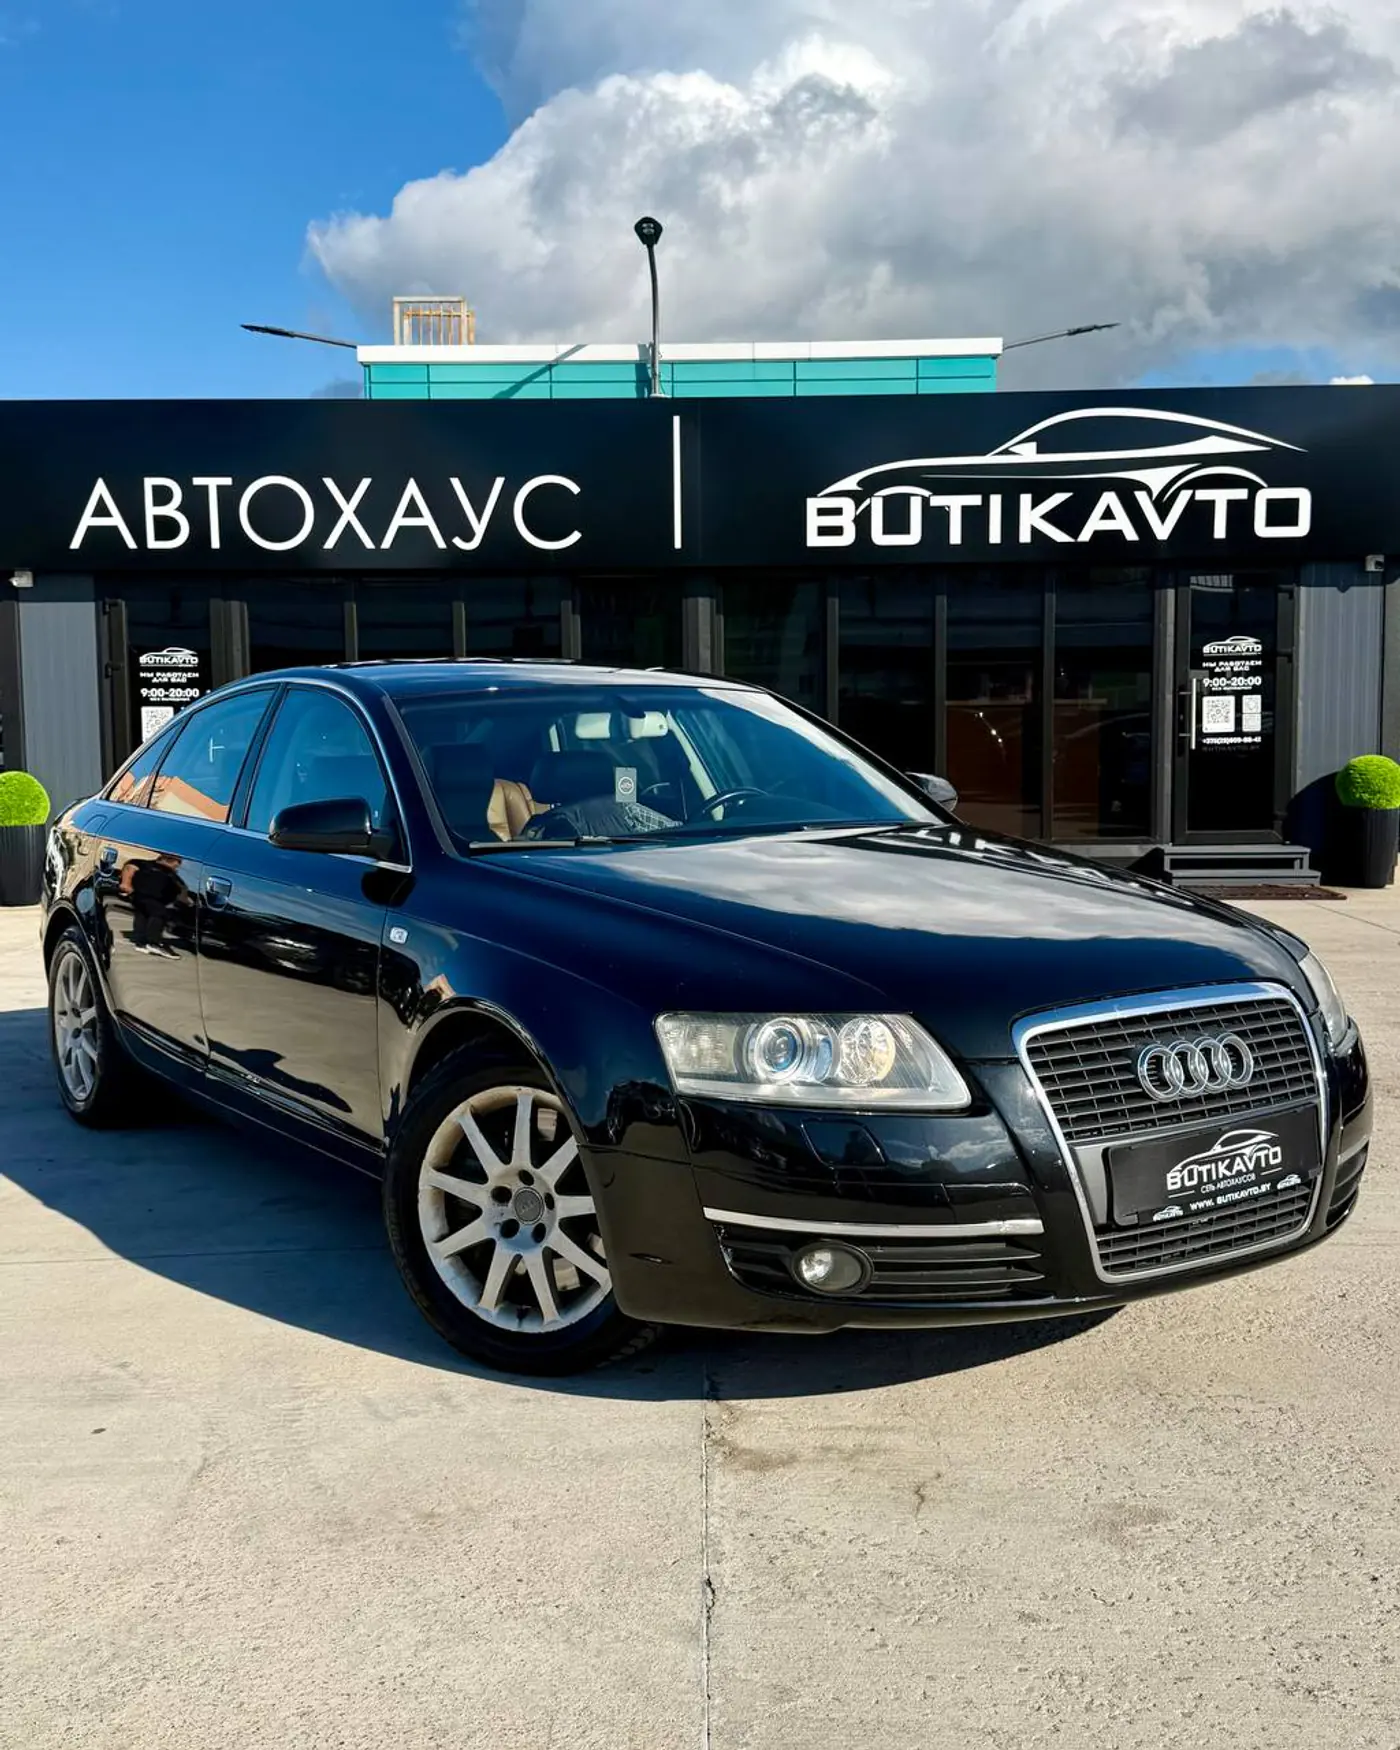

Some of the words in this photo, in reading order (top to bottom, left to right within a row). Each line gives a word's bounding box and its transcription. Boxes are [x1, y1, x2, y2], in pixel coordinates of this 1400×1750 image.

[70, 475, 582, 551] АВТОХАУС
[806, 487, 1312, 547] BUTIKAVTO
[140, 688, 200, 698] 9:00-20:00
[1203, 676, 1262, 688] 9:00-20:00
[1166, 1146, 1282, 1191] BUTIKAVTO
[1217, 1183, 1272, 1204] BUTIKAVTO.BY
